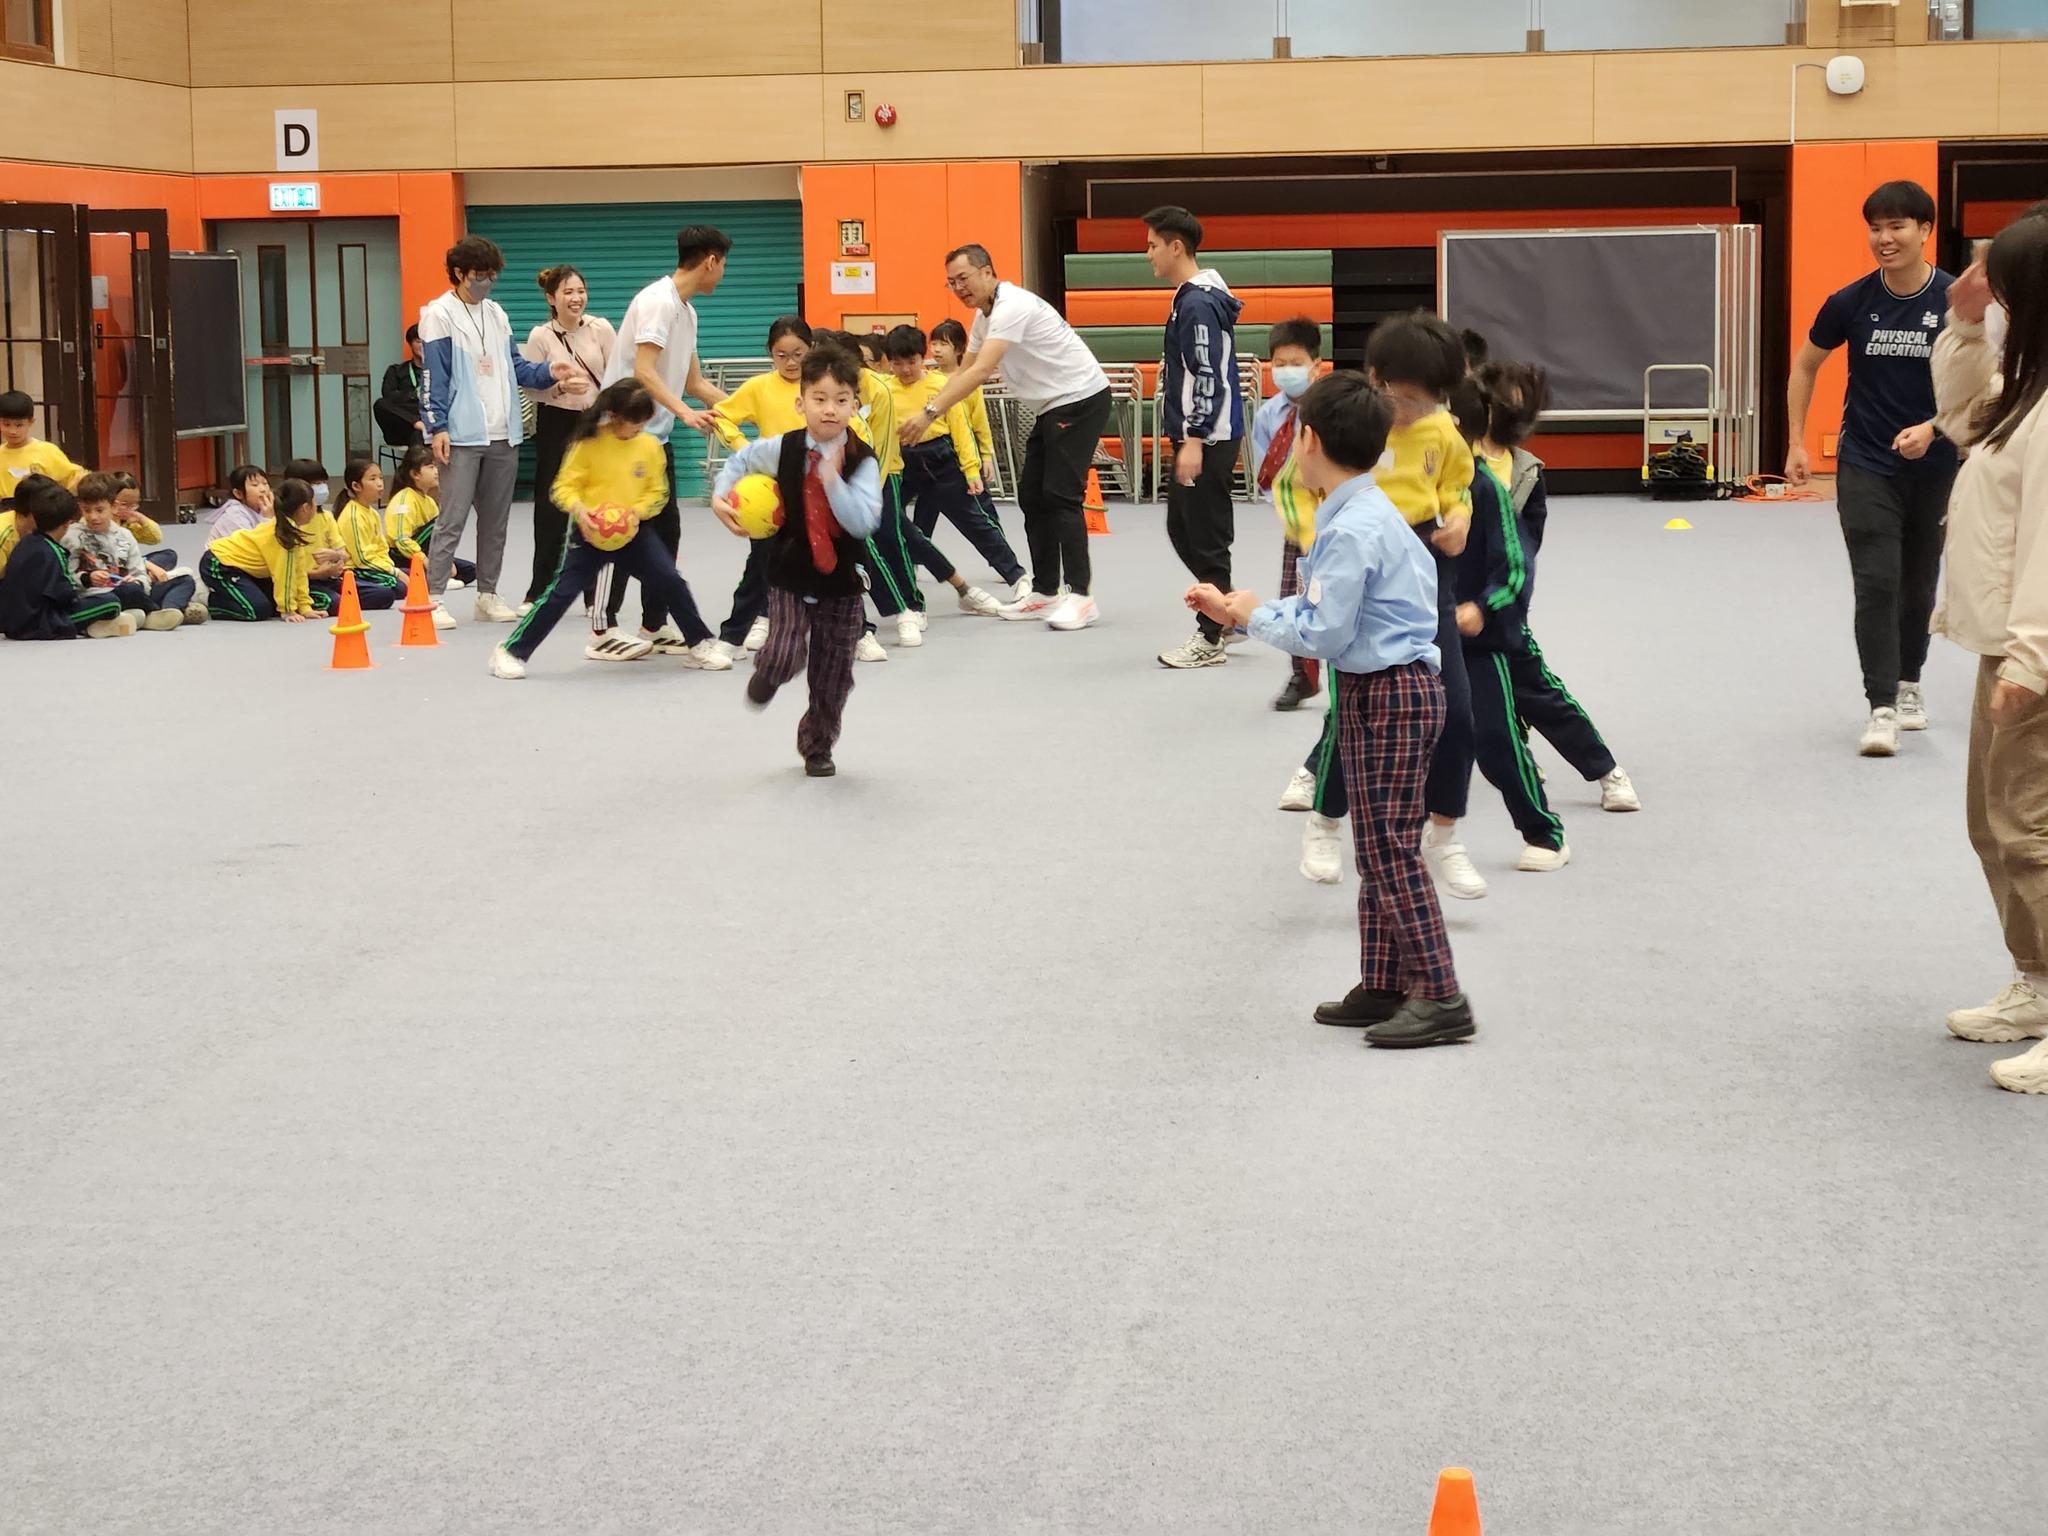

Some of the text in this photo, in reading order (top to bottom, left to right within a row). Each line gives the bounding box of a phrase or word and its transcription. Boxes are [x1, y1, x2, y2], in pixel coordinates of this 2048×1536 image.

[284, 124, 310, 156] D
[1871, 329, 1928, 344] PHYSICAL
[1865, 342, 1932, 357] EDUCATION
